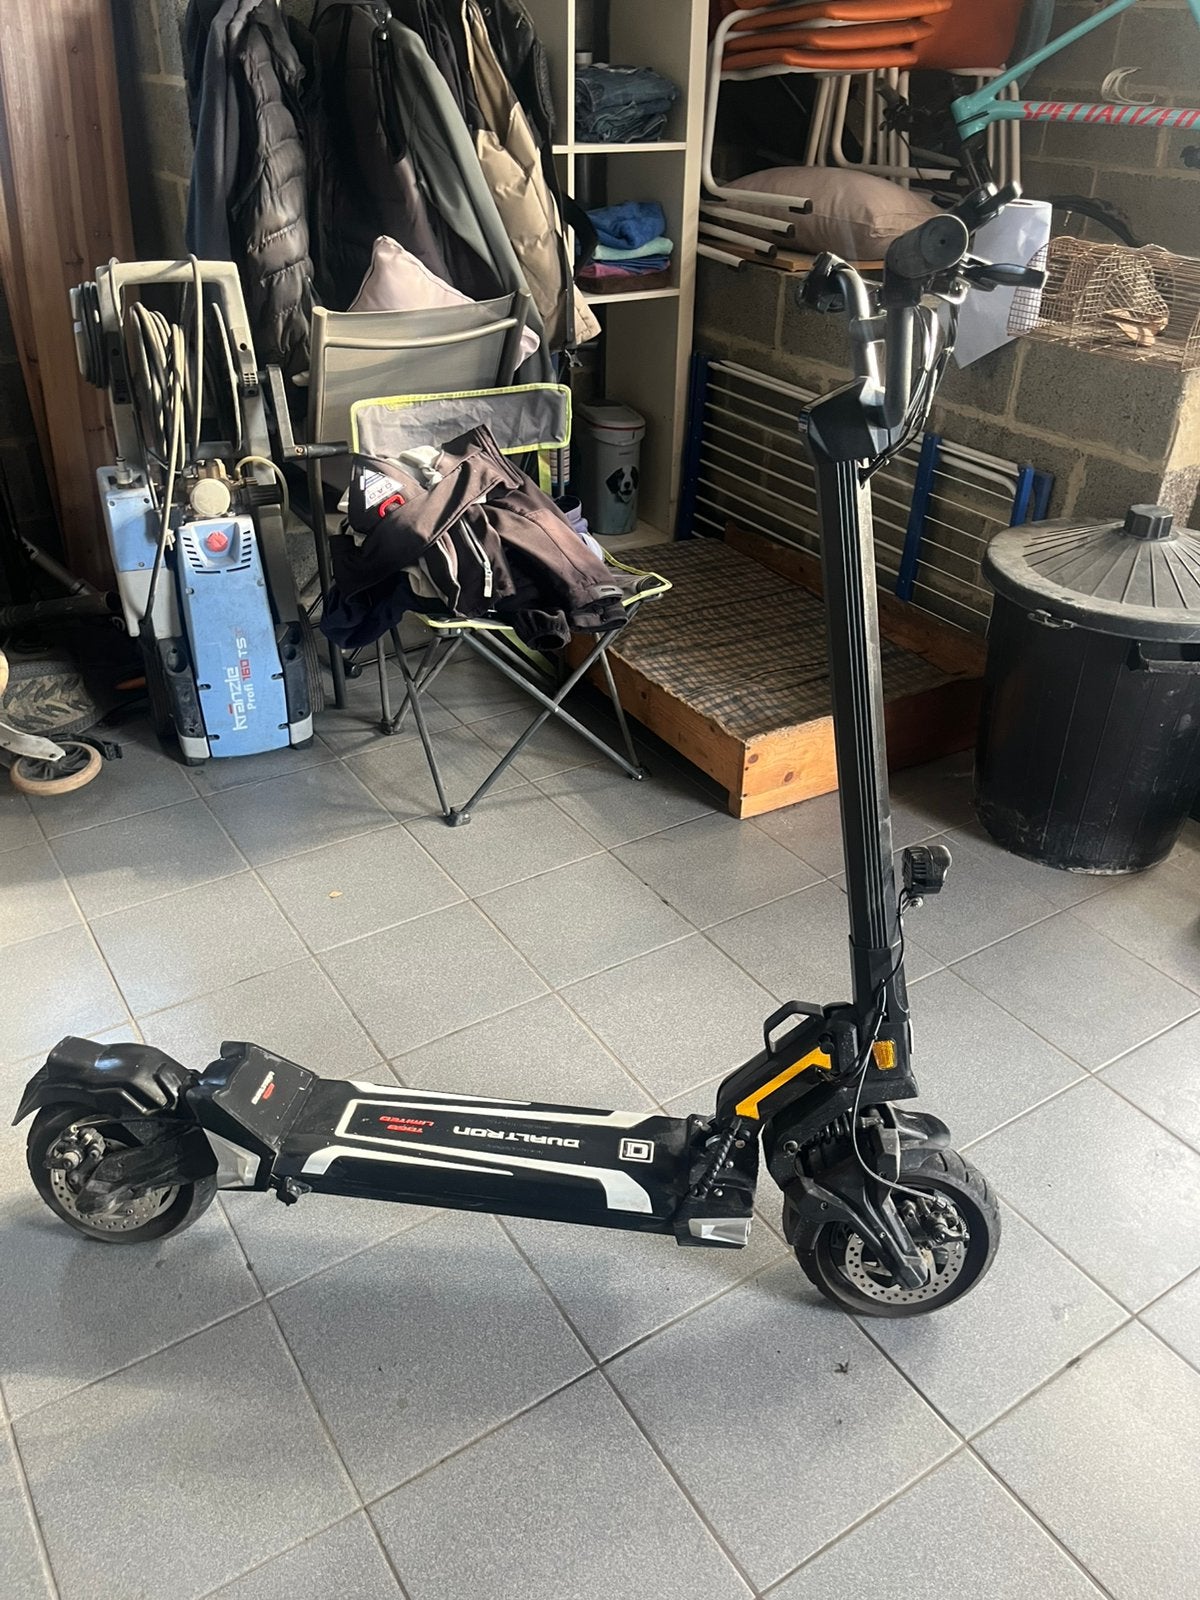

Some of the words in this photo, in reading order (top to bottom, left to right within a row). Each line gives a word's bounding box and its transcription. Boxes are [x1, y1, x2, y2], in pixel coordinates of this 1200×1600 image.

[1023, 102, 1200, 128] SPECIALIZED
[240, 659, 251, 681] 160
[244, 684, 256, 710] Profi
[380, 1115, 435, 1127] LIMITED
[453, 1125, 580, 1148] DUALTRON
